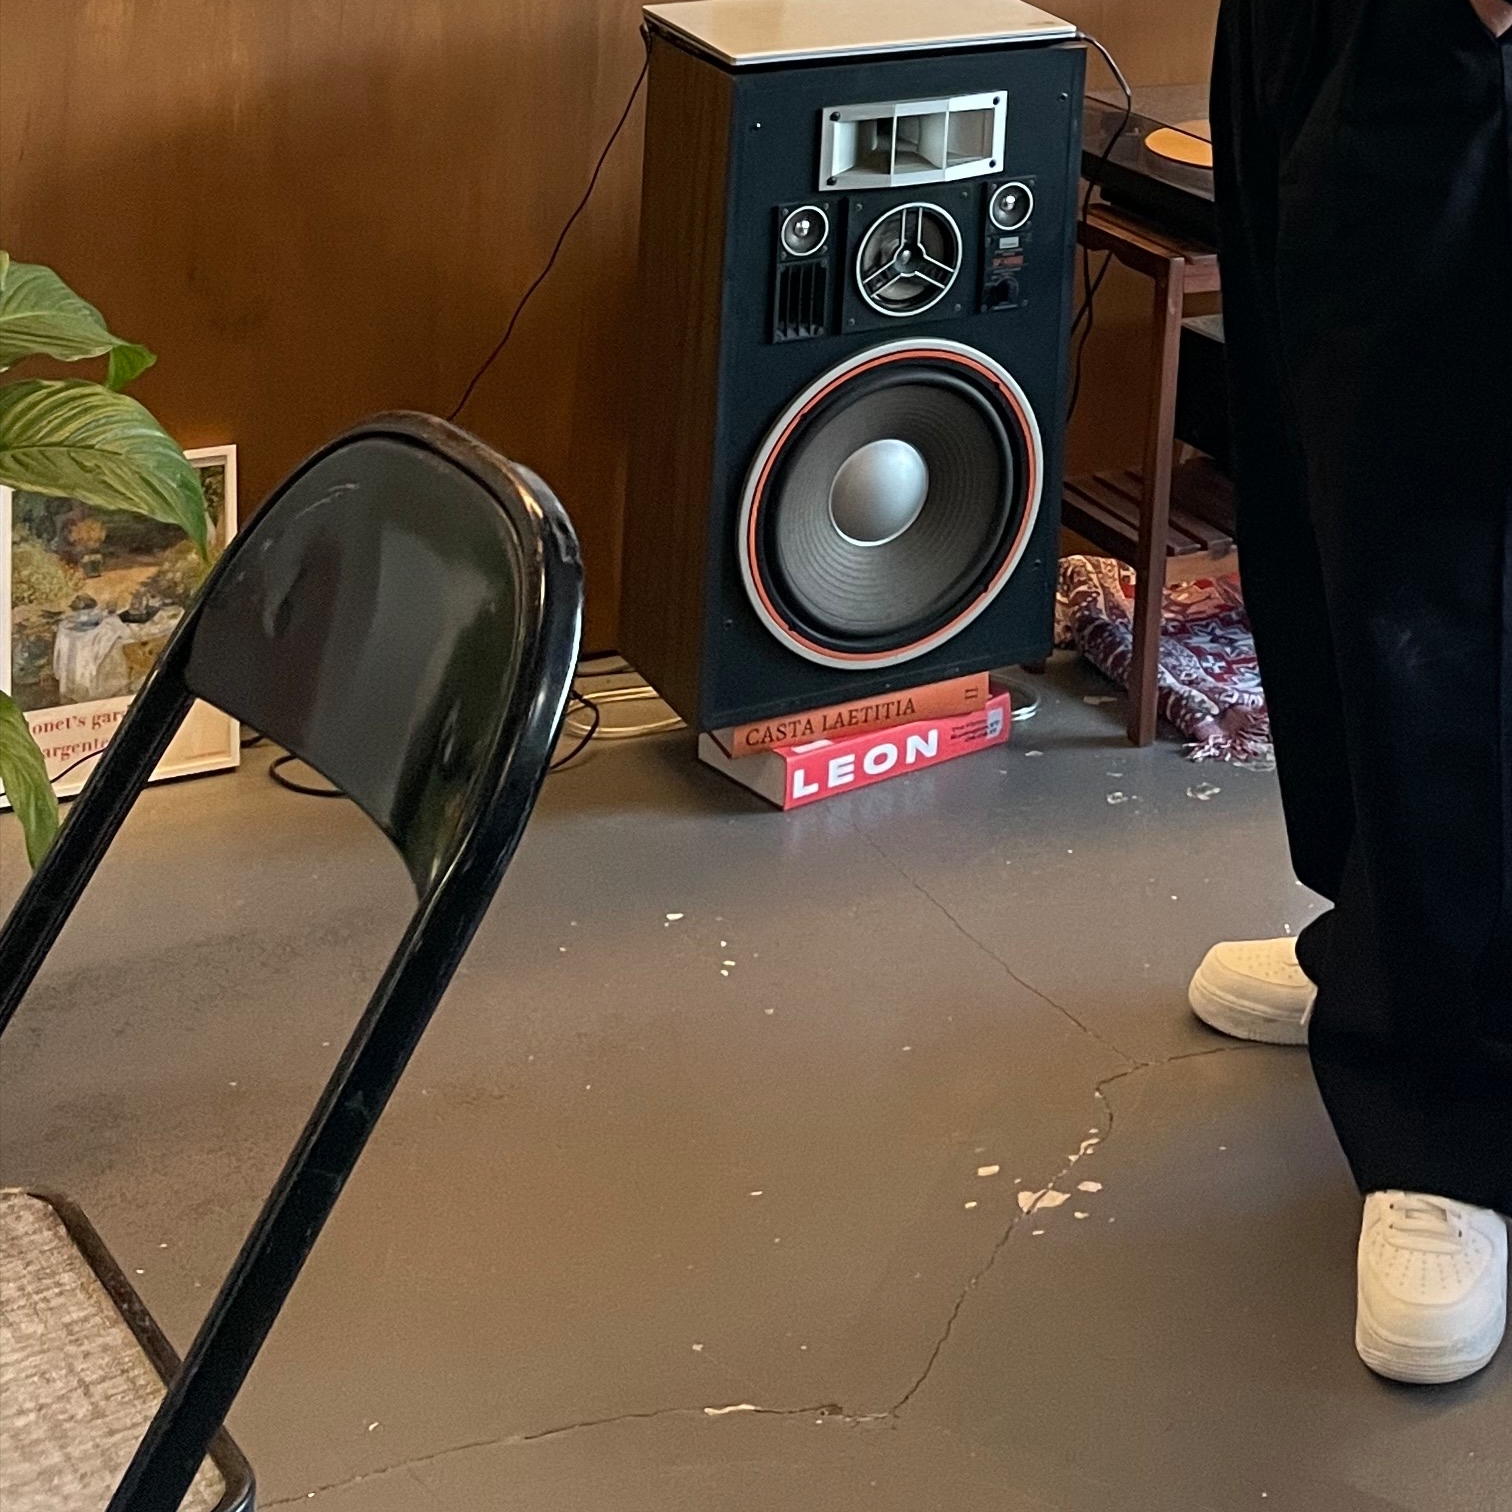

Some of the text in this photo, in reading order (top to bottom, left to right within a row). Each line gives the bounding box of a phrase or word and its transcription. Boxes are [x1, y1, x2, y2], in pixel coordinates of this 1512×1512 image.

[32, 715, 87, 735] onet's
[745, 717, 815, 747] CASTA
[821, 697, 918, 733] LAETITIA
[792, 728, 939, 800] LEON
